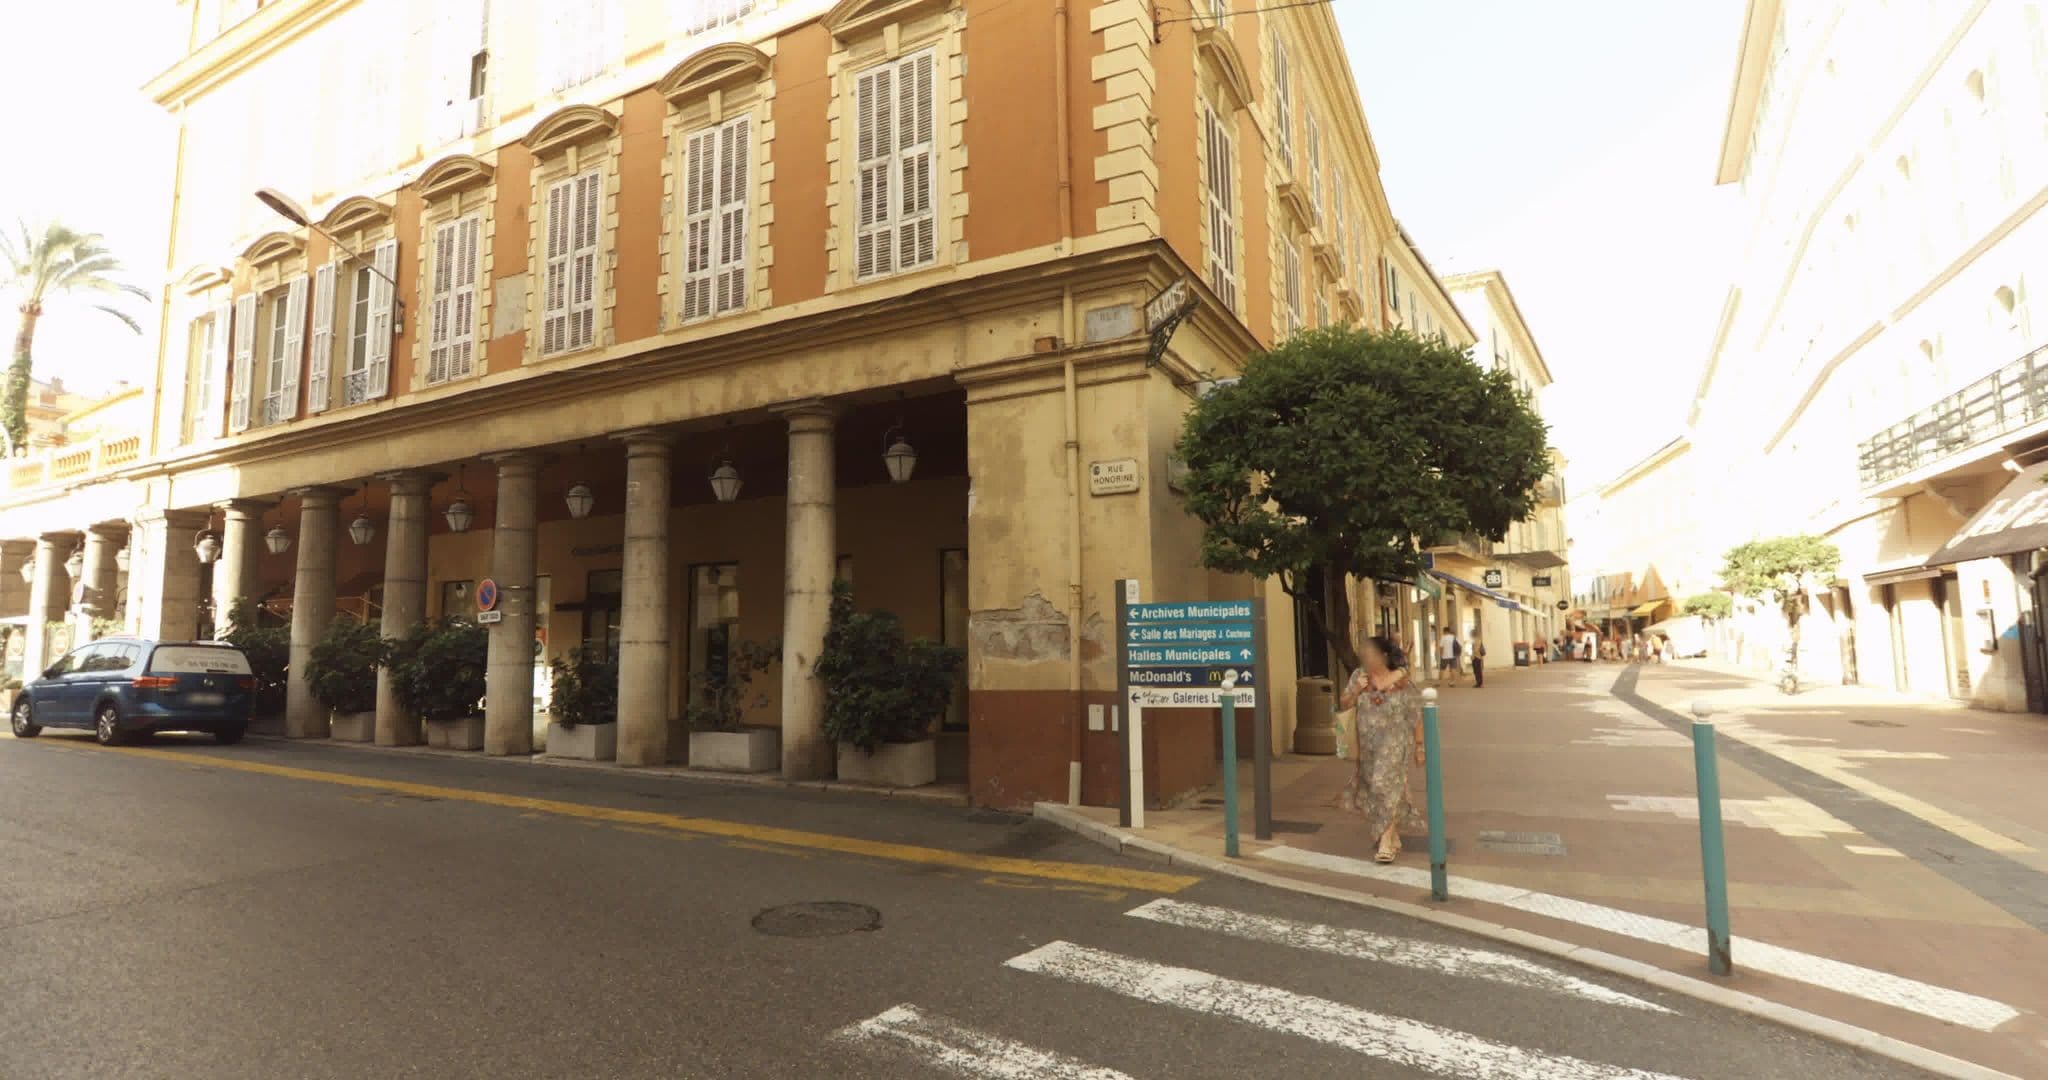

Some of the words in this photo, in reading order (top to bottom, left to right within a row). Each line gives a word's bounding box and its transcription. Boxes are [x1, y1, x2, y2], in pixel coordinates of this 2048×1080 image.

[1107, 464, 1125, 473] RUE
[1093, 473, 1134, 485] HONORINE
[1141, 607, 1185, 619] Archives
[1187, 604, 1251, 619] Municipales
[1141, 628, 1161, 640] Salle
[1163, 629, 1177, 640] des
[1179, 627, 1217, 642] Mariages
[1129, 649, 1162, 661] Halles
[1165, 648, 1232, 663] Municipales
[1129, 671, 1192, 683] McDonald's
[1173, 692, 1209, 704] Galeries
